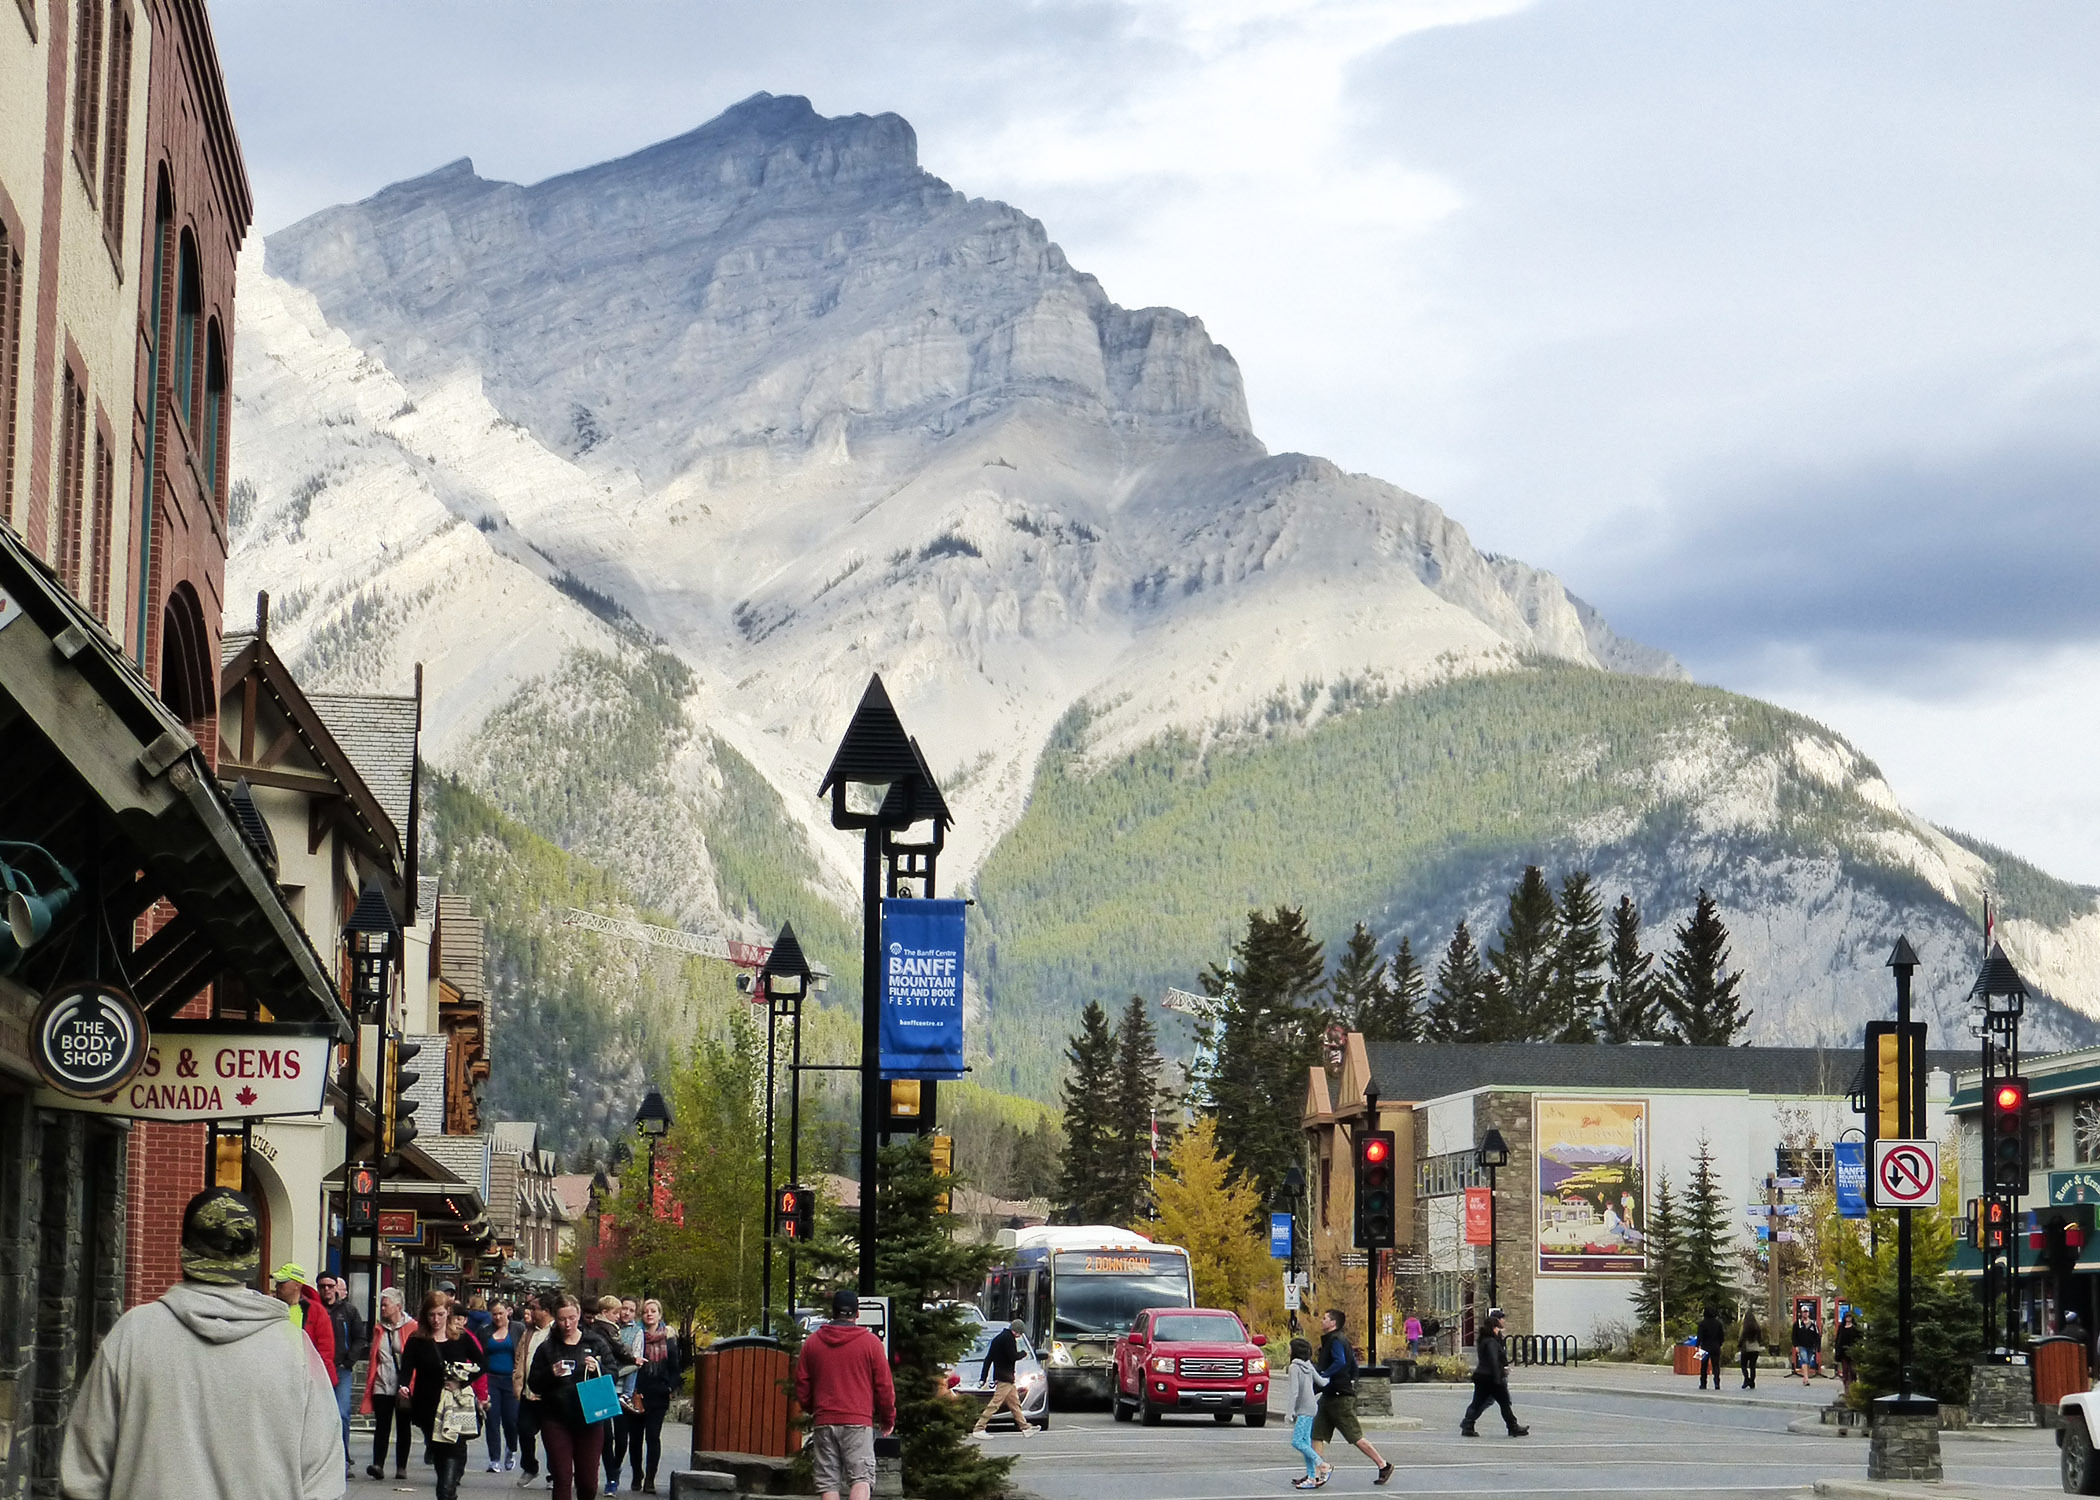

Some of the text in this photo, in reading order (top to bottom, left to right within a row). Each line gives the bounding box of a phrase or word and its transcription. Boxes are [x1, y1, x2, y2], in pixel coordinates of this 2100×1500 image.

[917, 949, 934, 957] Banff
[935, 949, 956, 957] Centre
[889, 957, 956, 977] BANFF
[889, 976, 956, 988] MOUNTAIN
[889, 988, 956, 998] FILM AND BOOK
[889, 997, 955, 1006] FESTIVAL
[73, 1021, 105, 1035] THE
[61, 1034, 117, 1051] BODY
[63, 1051, 113, 1067] SHOP
[176, 1048, 199, 1078] &
[215, 1049, 301, 1080] GEMS
[130, 1084, 223, 1110] CANADA
[1838, 1167, 1866, 1175] BANFF
[2073, 1174, 2082, 1185] &
[362, 1201, 370, 1219] 4
[785, 1220, 796, 1238] 4
[1994, 1230, 2003, 1246] 4
[1085, 1256, 1151, 1272] 2 DOWNTOWN
